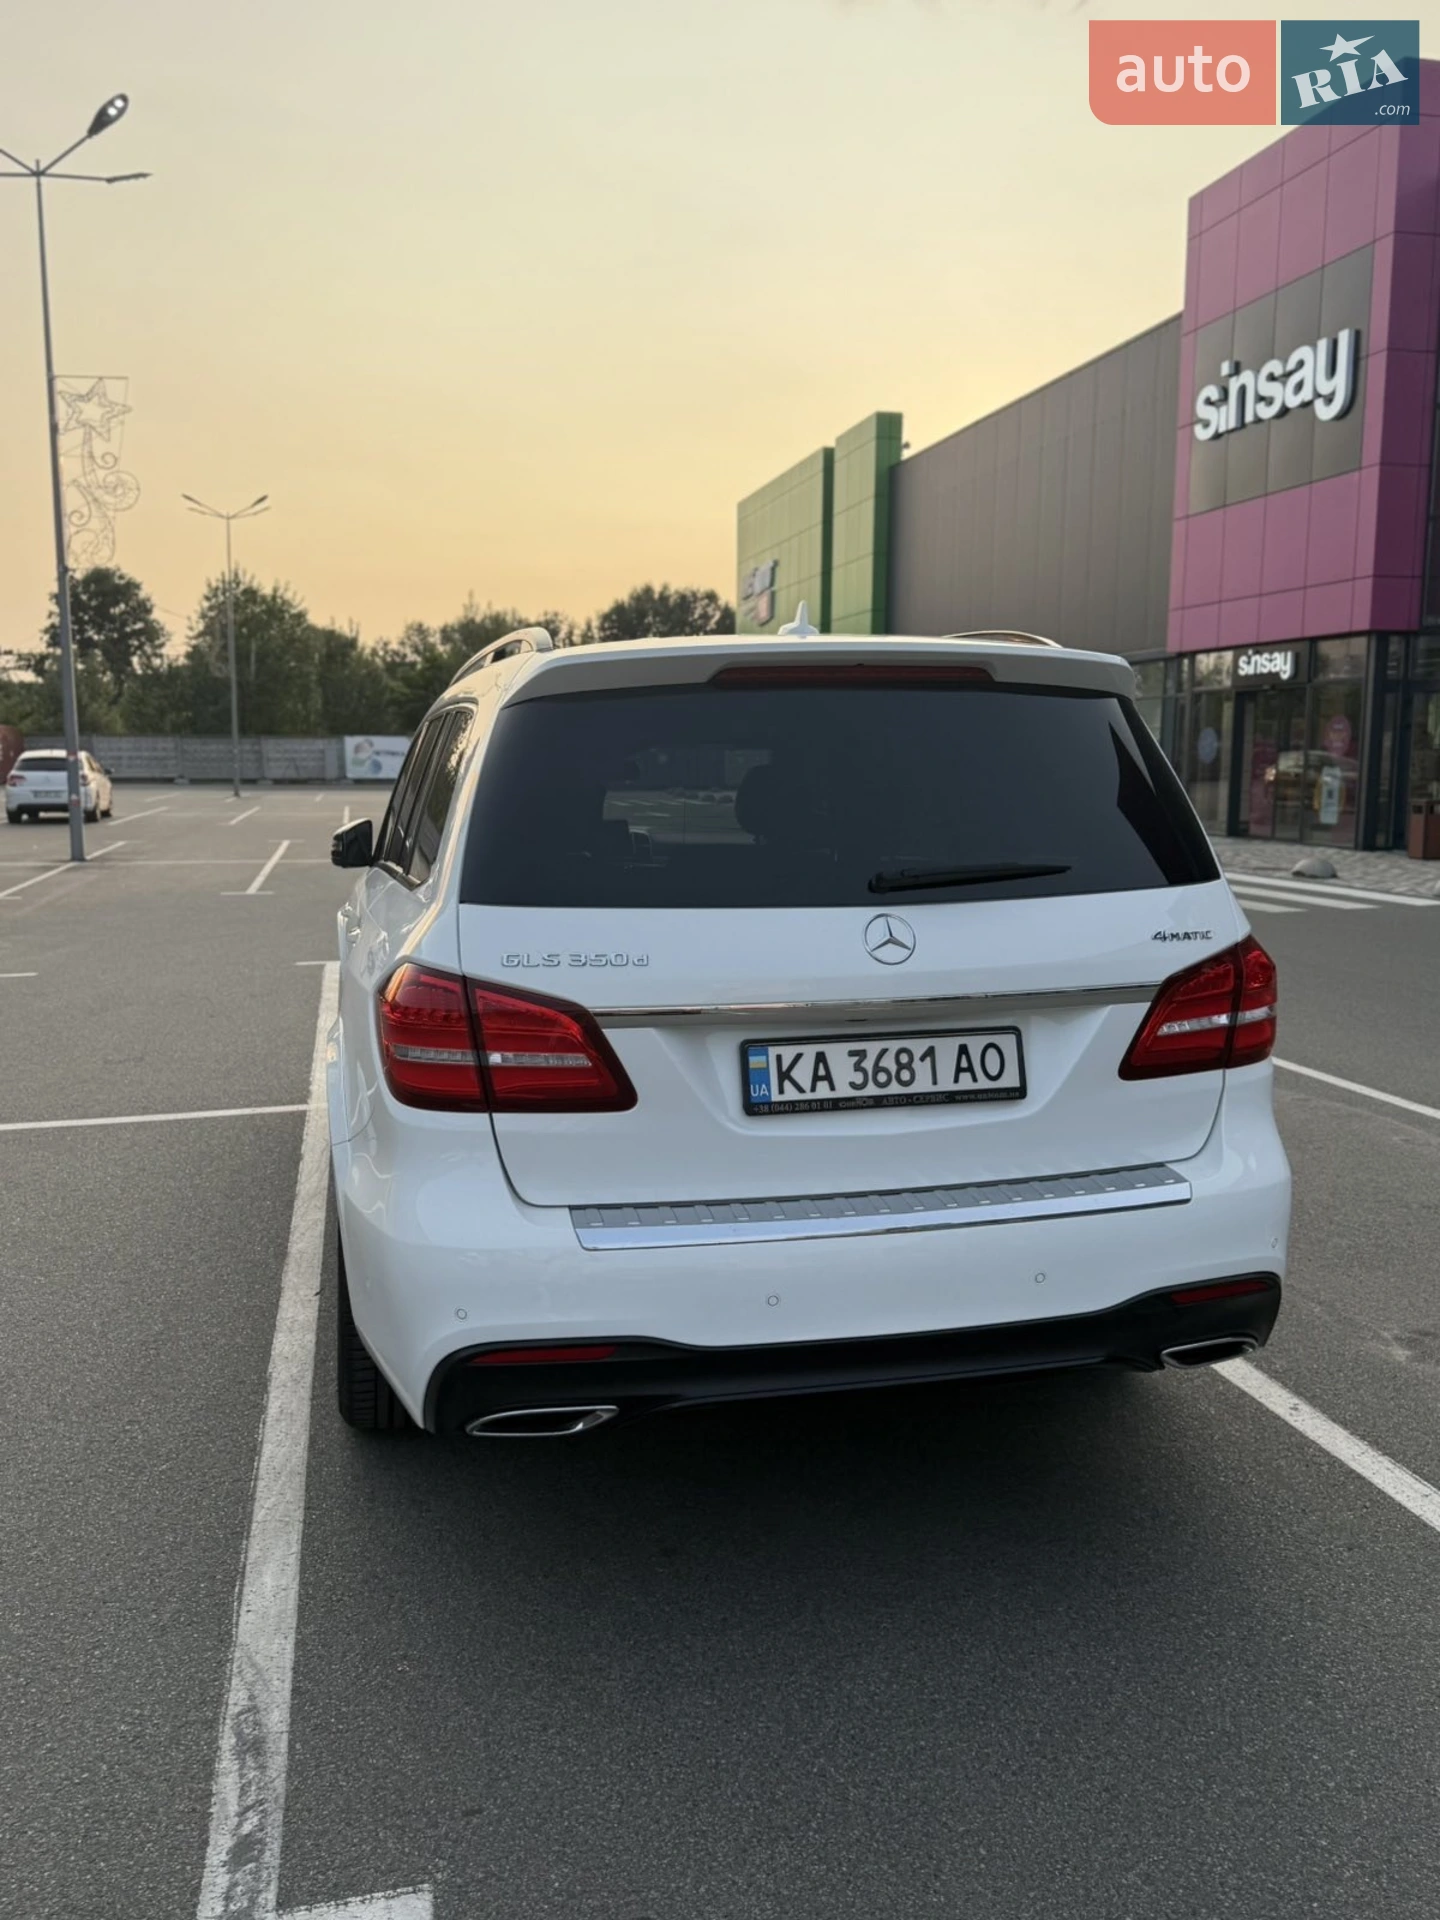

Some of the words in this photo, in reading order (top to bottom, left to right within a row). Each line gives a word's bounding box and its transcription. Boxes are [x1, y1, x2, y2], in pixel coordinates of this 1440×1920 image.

[1194, 328, 1354, 441] sinsay
[1238, 649, 1293, 680] sinsay
[1151, 930, 1213, 942] 4MATIC
[501, 952, 561, 968] GLS
[775, 1051, 836, 1095] KA
[847, 1045, 938, 1091] 3681
[953, 1042, 1006, 1084] AO
[750, 1084, 769, 1097] UA
